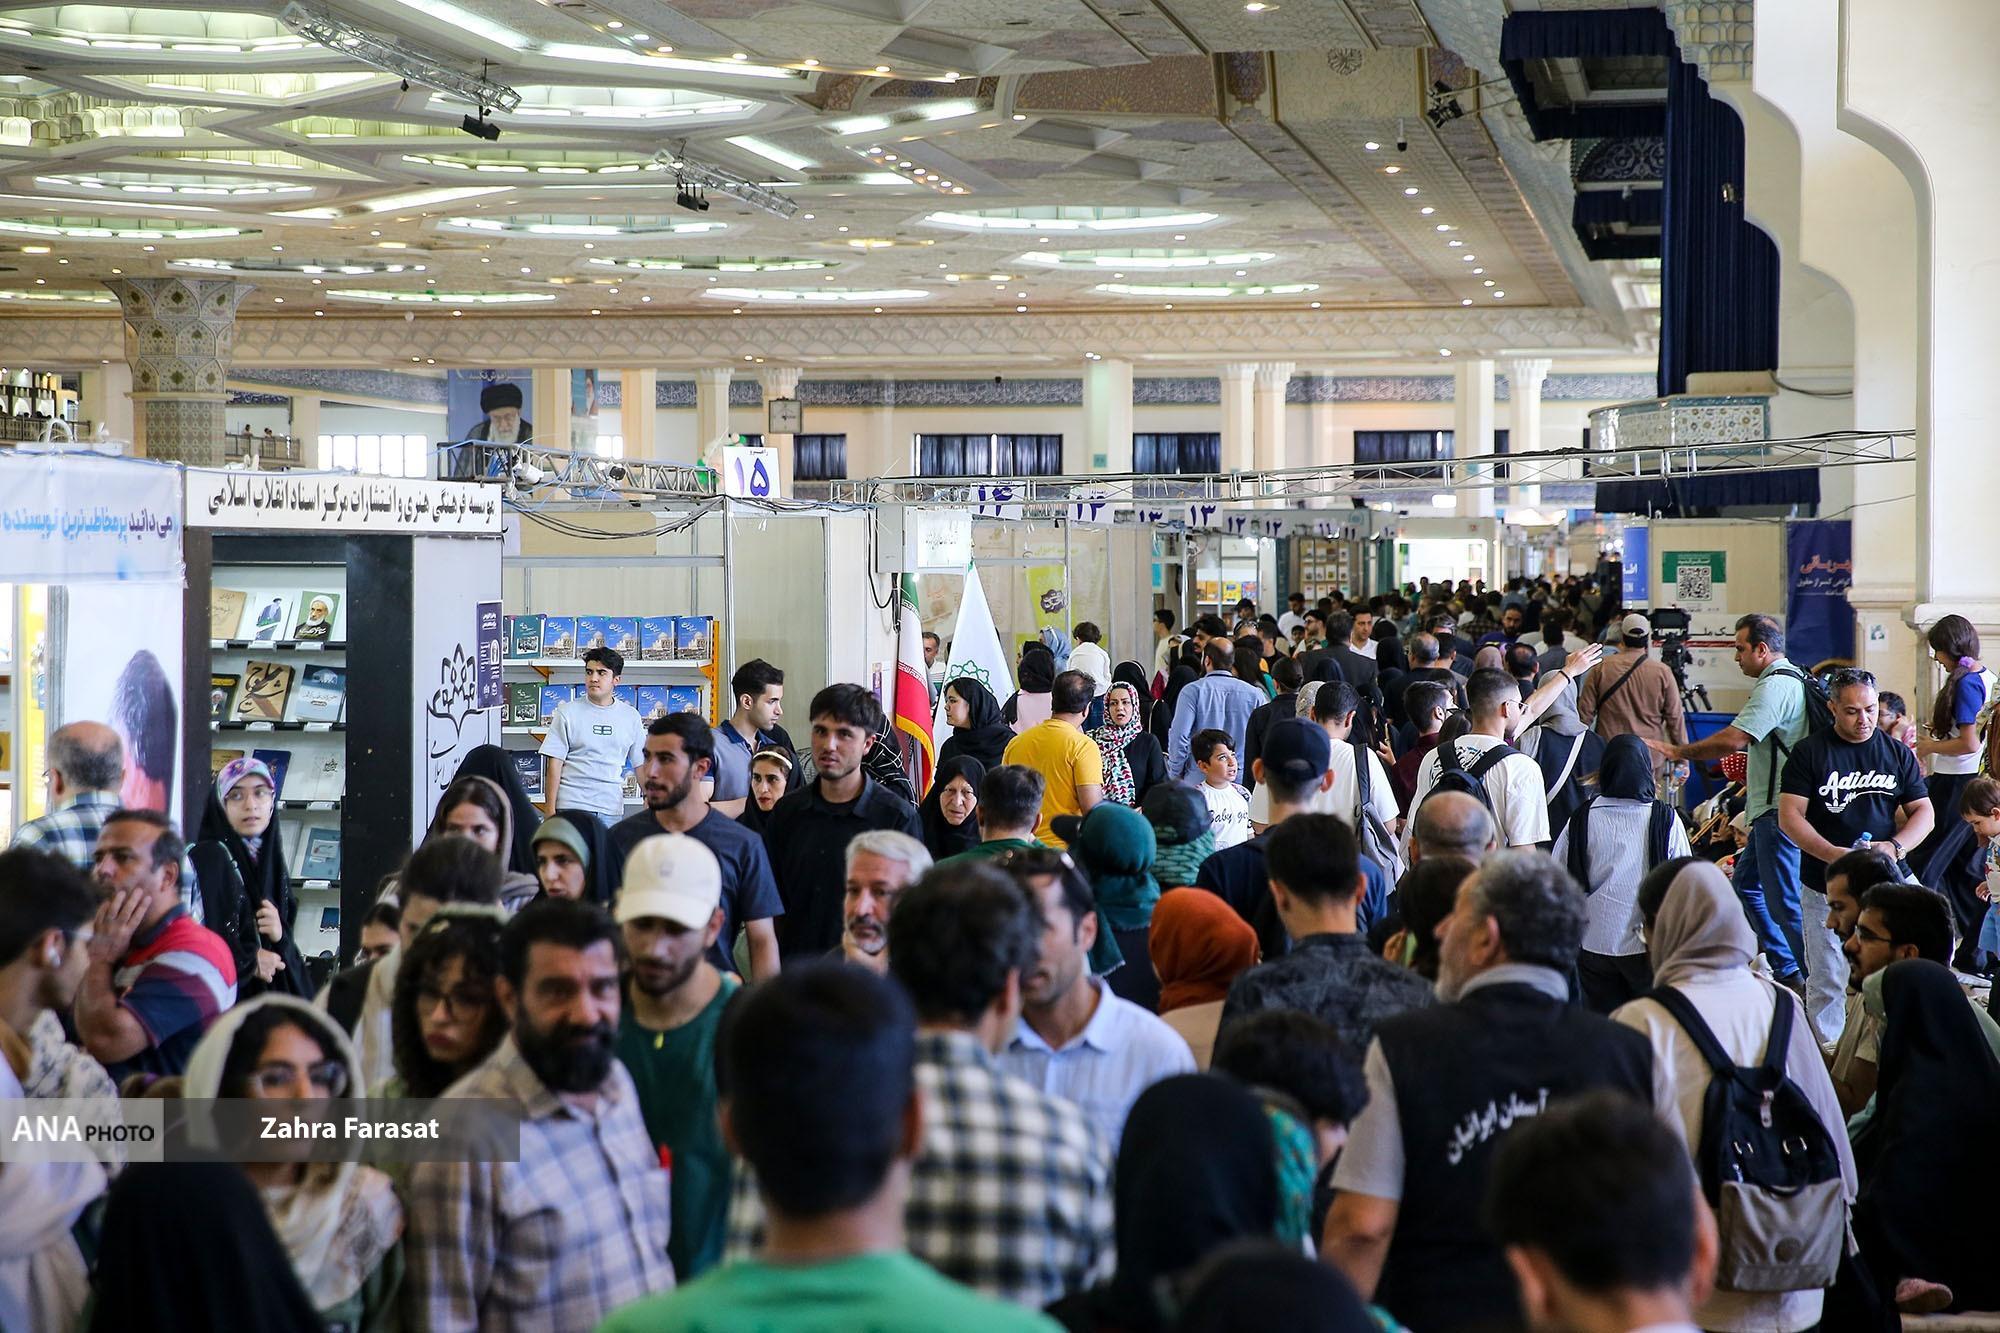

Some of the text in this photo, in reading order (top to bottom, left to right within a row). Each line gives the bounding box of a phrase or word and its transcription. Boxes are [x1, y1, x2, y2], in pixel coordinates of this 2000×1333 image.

[735, 457, 770, 496] ۱۵
[208, 473, 251, 516] اسلامی
[253, 476, 289, 517] انقلاب
[291, 481, 320, 511] اسناد
[321, 483, 348, 521] مرکز
[350, 483, 397, 522] انتشارات
[397, 497, 403, 523] و
[404, 490, 429, 523] هنری
[432, 485, 466, 523] فرهنگی
[978, 485, 1013, 517] ۱۴
[2, 508, 58, 539] نویسنده
[1139, 509, 1163, 523] ۱۳
[1190, 504, 1216, 526] ۱۳
[1819, 770, 1897, 799] Adidas
